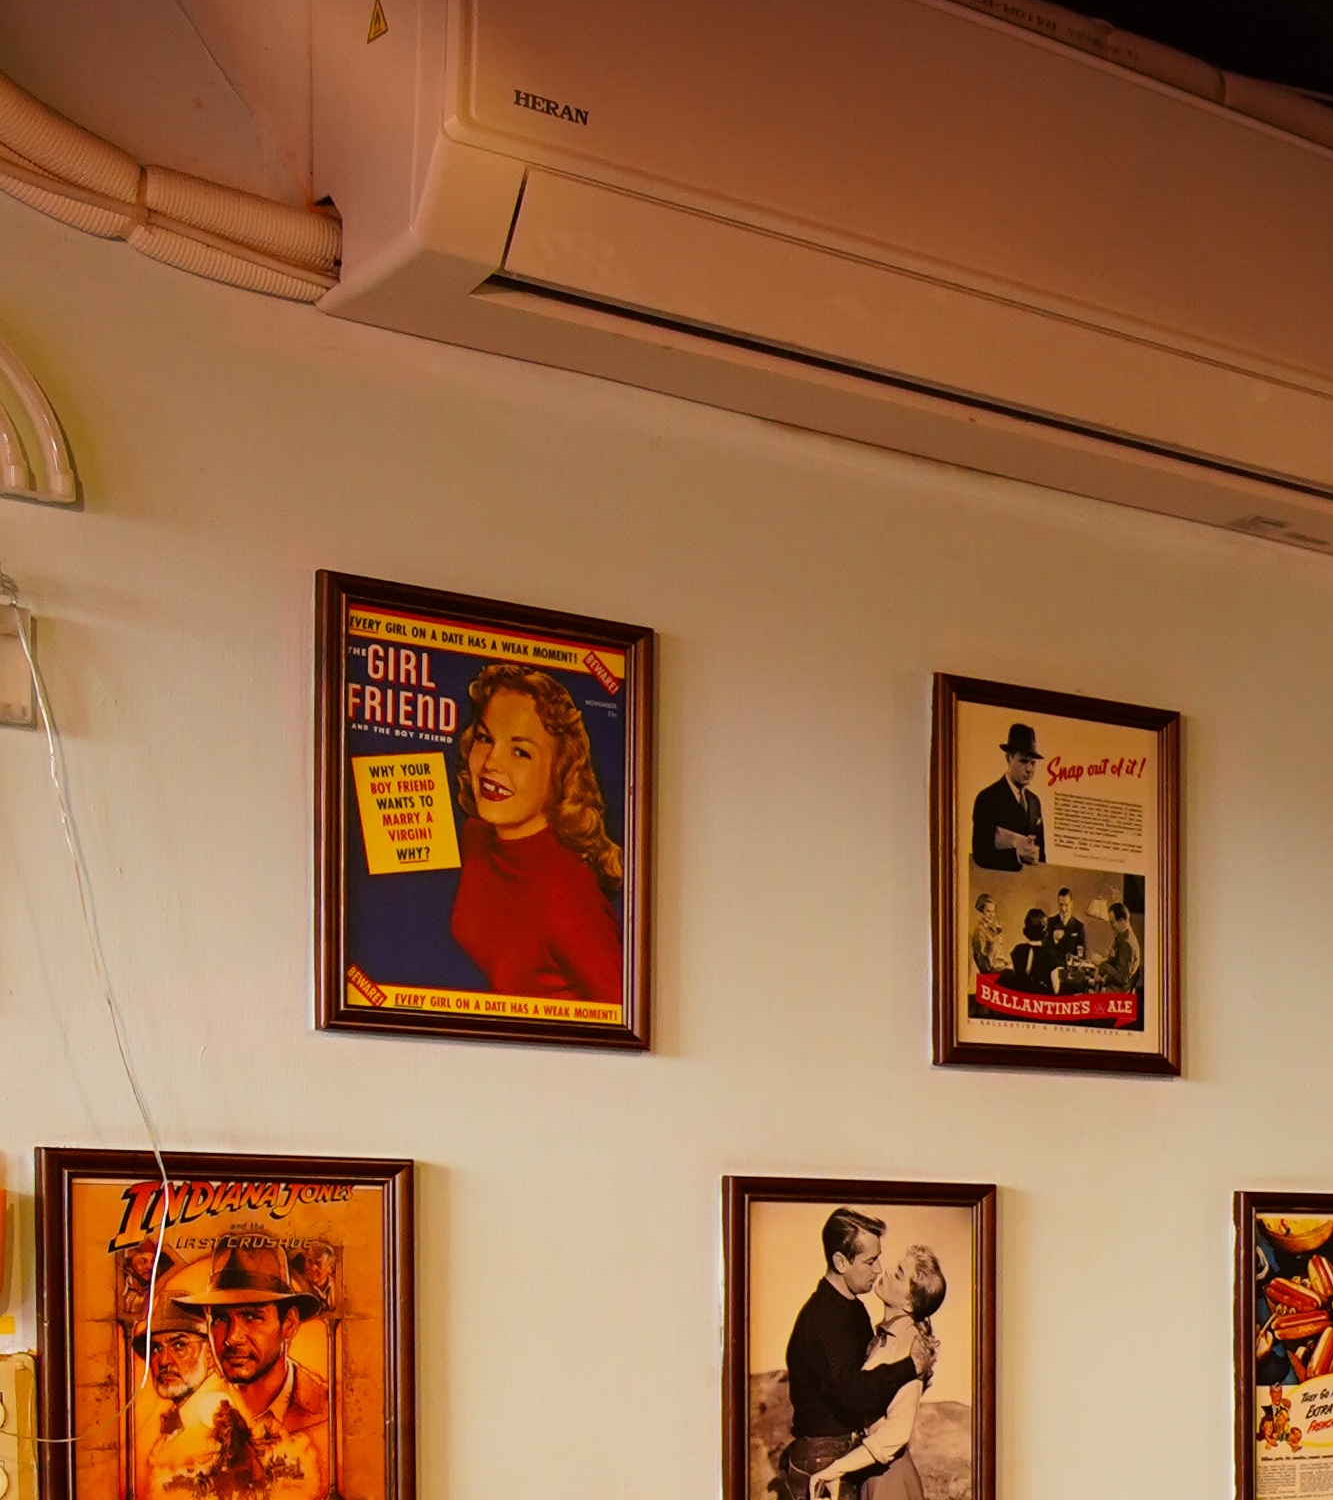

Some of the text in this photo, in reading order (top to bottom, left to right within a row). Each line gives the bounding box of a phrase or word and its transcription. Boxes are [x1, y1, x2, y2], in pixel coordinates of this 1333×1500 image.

[513, 88, 590, 127] HERAN
[349, 615, 577, 664] EVERY GIRL ON A DATE HAS A WEAK MOMENT!
[348, 647, 366, 658] THE
[367, 644, 436, 689] GIRL
[584, 652, 620, 693] BEWARE!
[348, 685, 457, 733] FRIEND
[351, 723, 453, 744] AND THE BOY FRIEND
[369, 763, 431, 778] WHY YOUR
[1047, 756, 1083, 786] Snap
[1087, 759, 1109, 777] out
[1111, 758, 1123, 778] of
[370, 779, 435, 794] BOY FRIEND
[376, 796, 433, 810] WANTS TO
[382, 812, 433, 826] MARRY A
[388, 828, 431, 841] VIRGIN!
[396, 846, 430, 861] WHY?
[348, 965, 386, 1005] BEWARE!
[395, 993, 617, 1020] EVERY GIRL ON A DATE HAS A WEAK MOMENT!
[981, 985, 1132, 1015] BALLANTINE'S ALE
[108, 1181, 355, 1253] INDIANA JONES
[230, 1221, 264, 1230] and the
[176, 1235, 313, 1249] LAST CRUSADE
[1306, 1403, 1333, 1419] EXTRA
